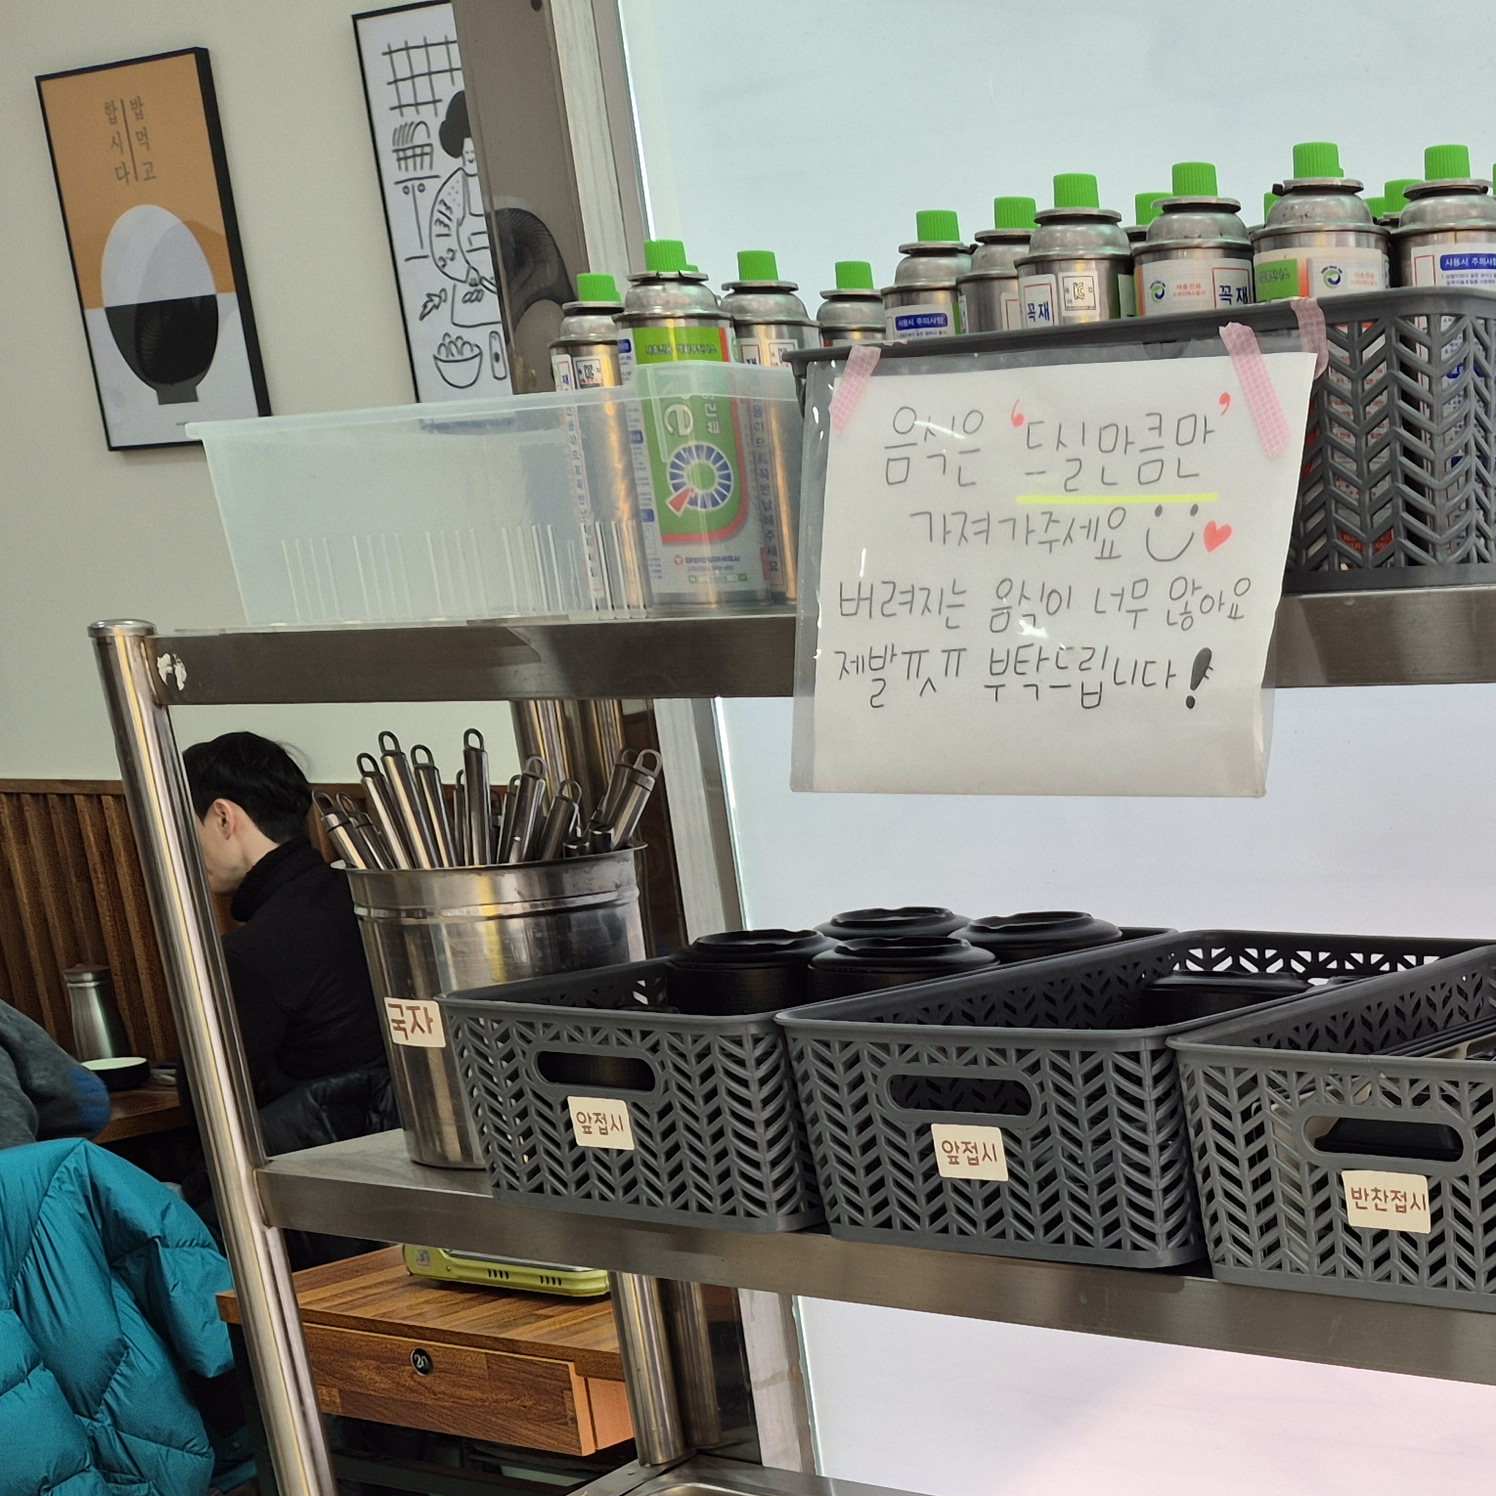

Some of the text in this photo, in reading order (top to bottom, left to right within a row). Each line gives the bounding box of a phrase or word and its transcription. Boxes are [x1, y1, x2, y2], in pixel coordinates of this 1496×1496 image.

[884, 405, 984, 488] 음식은
[909, 506, 1127, 560] 가져가주세요
[839, 578, 967, 630] 버려지는
[989, 577, 1073, 634] 음식이
[1094, 578, 1149, 630] 너무
[387, 1003, 434, 1041] 국자
[575, 1111, 625, 1136] 앞접시
[941, 1139, 998, 1167] 앞접시
[1350, 1186, 1427, 1214] 반찬접시
